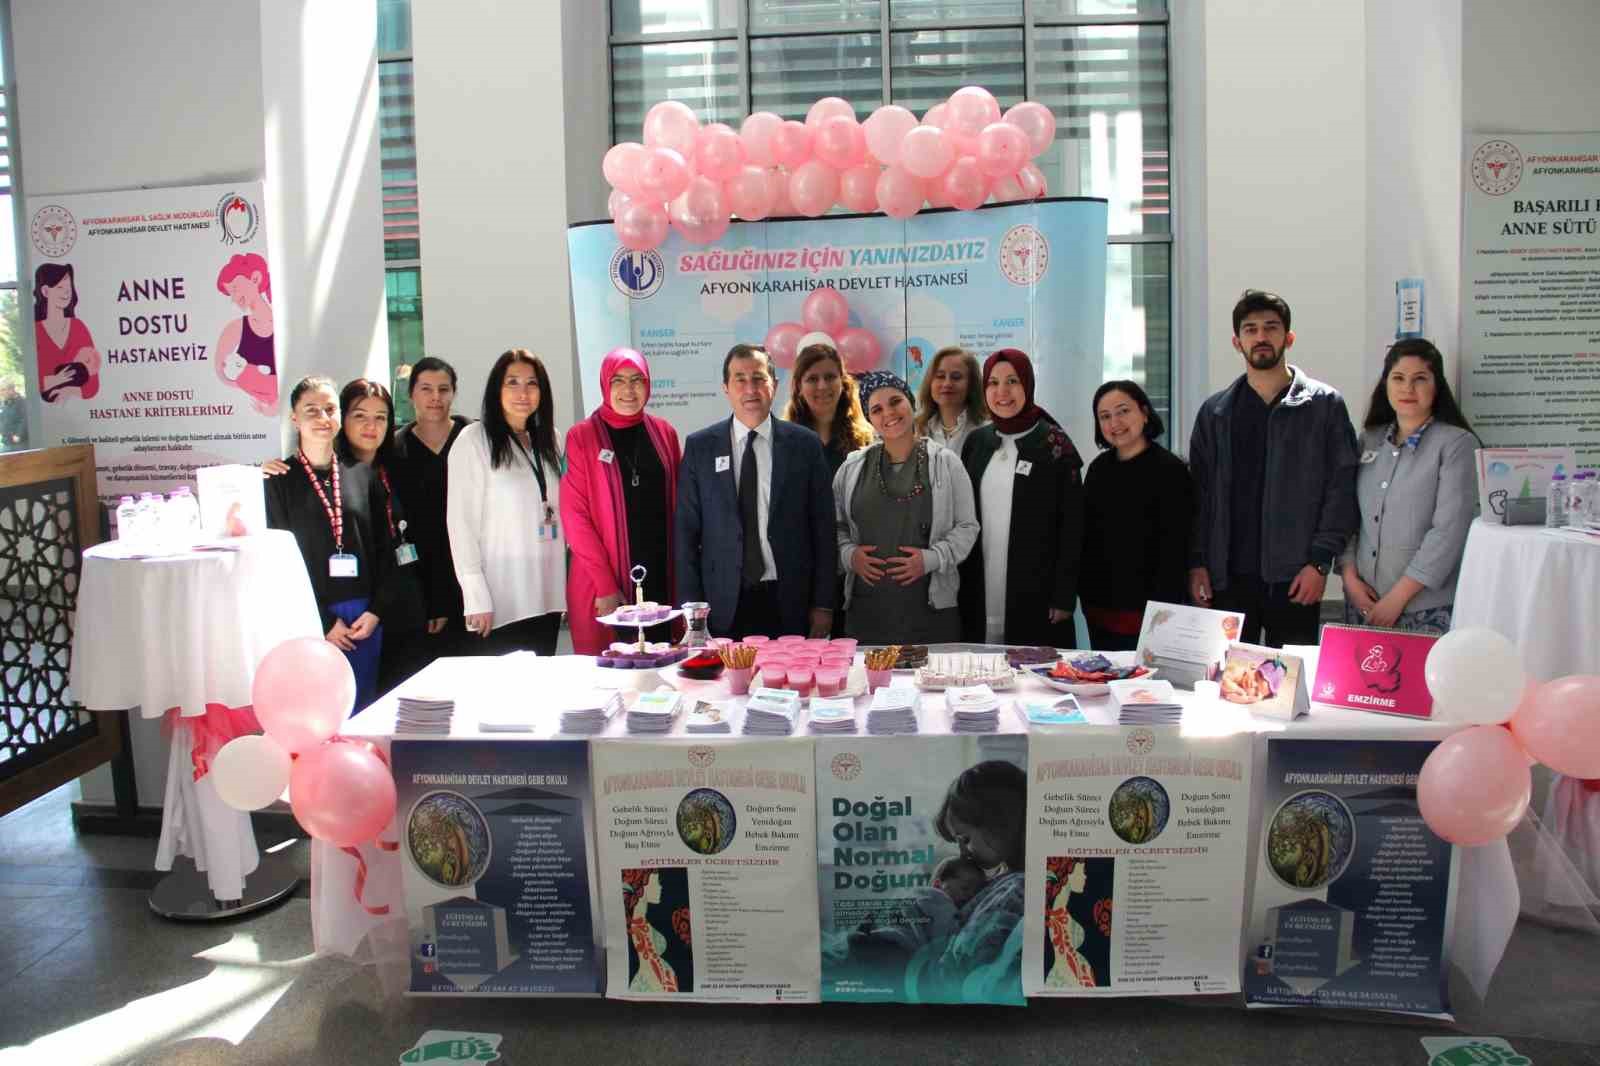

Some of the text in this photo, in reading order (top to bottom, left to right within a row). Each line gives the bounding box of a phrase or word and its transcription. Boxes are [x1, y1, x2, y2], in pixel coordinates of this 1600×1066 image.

[1513, 199, 1589, 216] BAŞARILI
[88, 221, 210, 236] AFYONKARAHİSAR DEVLET HASTANESİ
[1502, 218, 1597, 235] ANNE SÜTÜ
[679, 250, 799, 273] SAĞLIĞINIZ
[800, 246, 844, 273] İÇİN
[849, 241, 985, 266] YANINIZDAYIZ
[117, 278, 185, 302] ANNE
[699, 269, 968, 295] AFYONKARAHİSAR DEVLET HASTANESİ
[119, 313, 187, 336] DOSTU
[108, 346, 208, 364] HASTANEYİZ
[122, 389, 194, 402] ANNE DOSTU
[90, 404, 234, 420] HASTANE KRİTERLERİMİZ
[1347, 693, 1396, 708] EMZİRME
[1181, 792, 1210, 802] Doğum
[745, 804, 774, 814] Doğum
[832, 796, 912, 821] Doğal
[1044, 805, 1074, 815] Doğum
[614, 817, 642, 827] Doğum
[833, 821, 897, 842] Olan
[834, 845, 935, 867] Normal
[834, 870, 932, 893] Doğum
